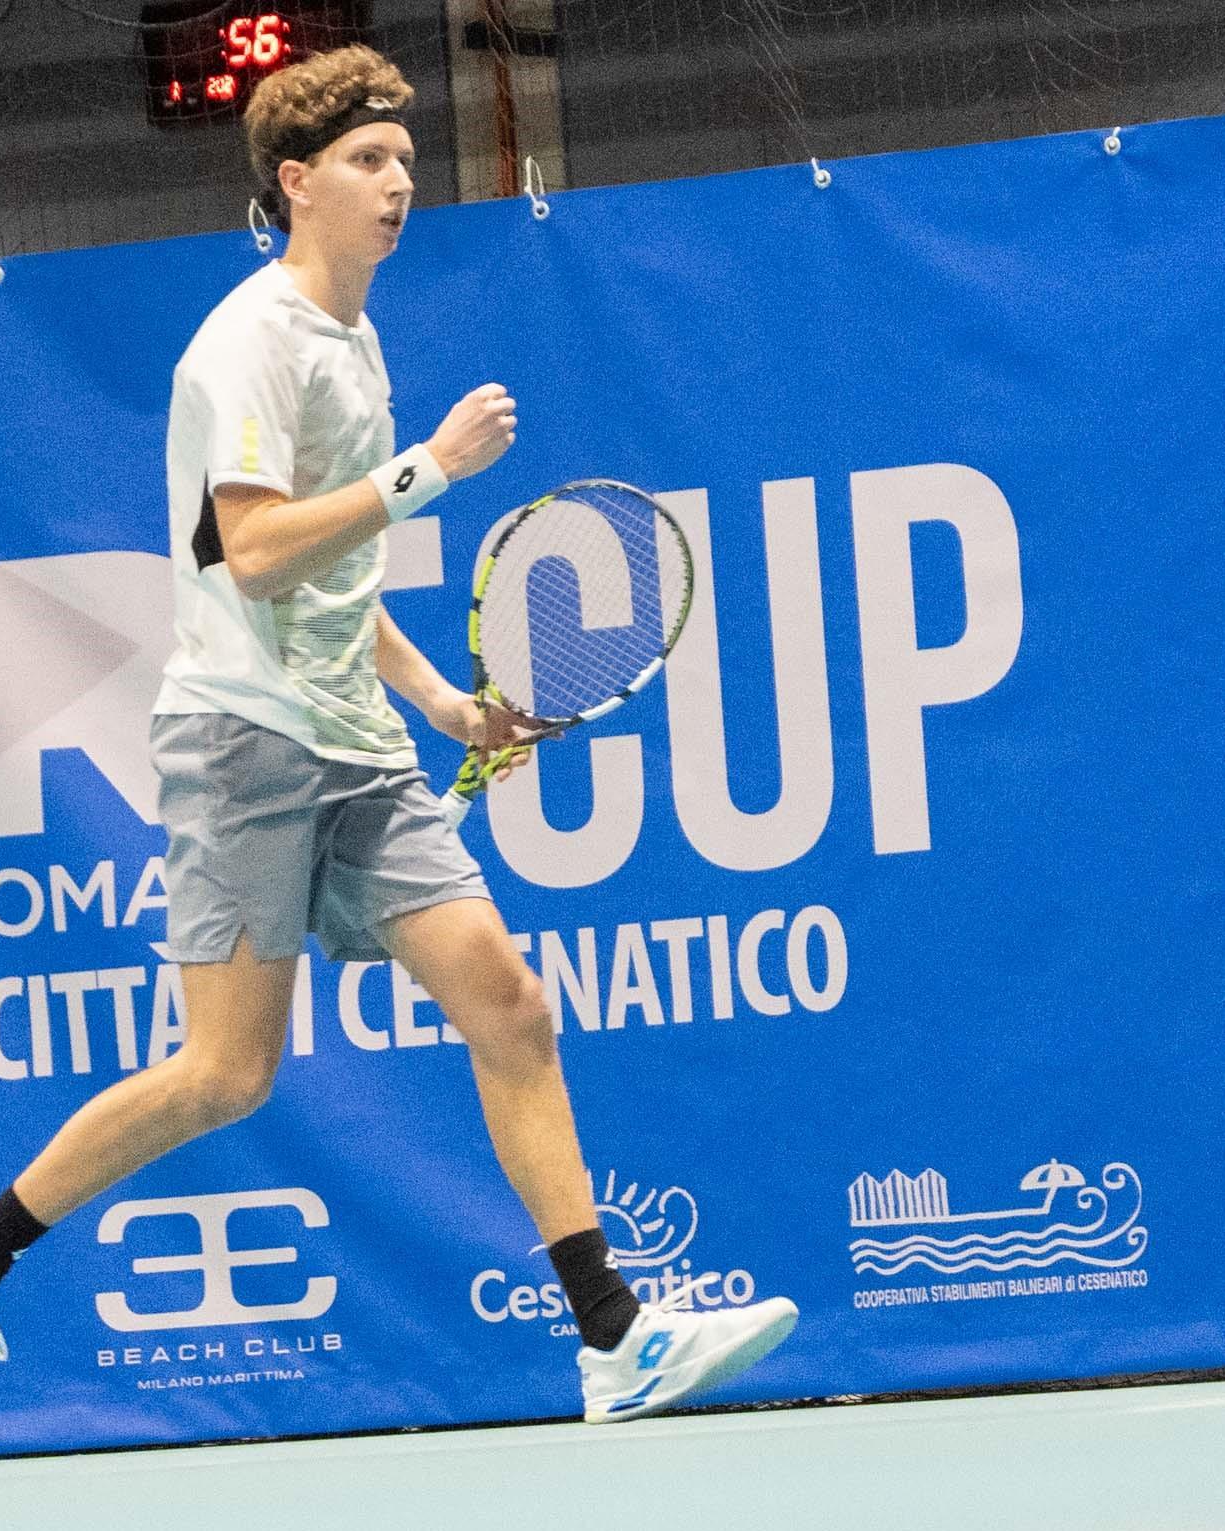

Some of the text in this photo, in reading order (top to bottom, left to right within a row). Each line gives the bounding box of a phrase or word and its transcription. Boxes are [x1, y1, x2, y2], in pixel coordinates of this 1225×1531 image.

[473, 463, 1024, 889] CUP
[338, 904, 849, 1051] CENATICO
[470, 1257, 755, 1323] Cesatico
[854, 1269, 1148, 1309] COOPERATIVA STABILIMENTI BALNEARI di CESENATICO
[97, 1333, 343, 1367] BEACH CLUB
[137, 1368, 306, 1391] MILANO MARITTIMA
